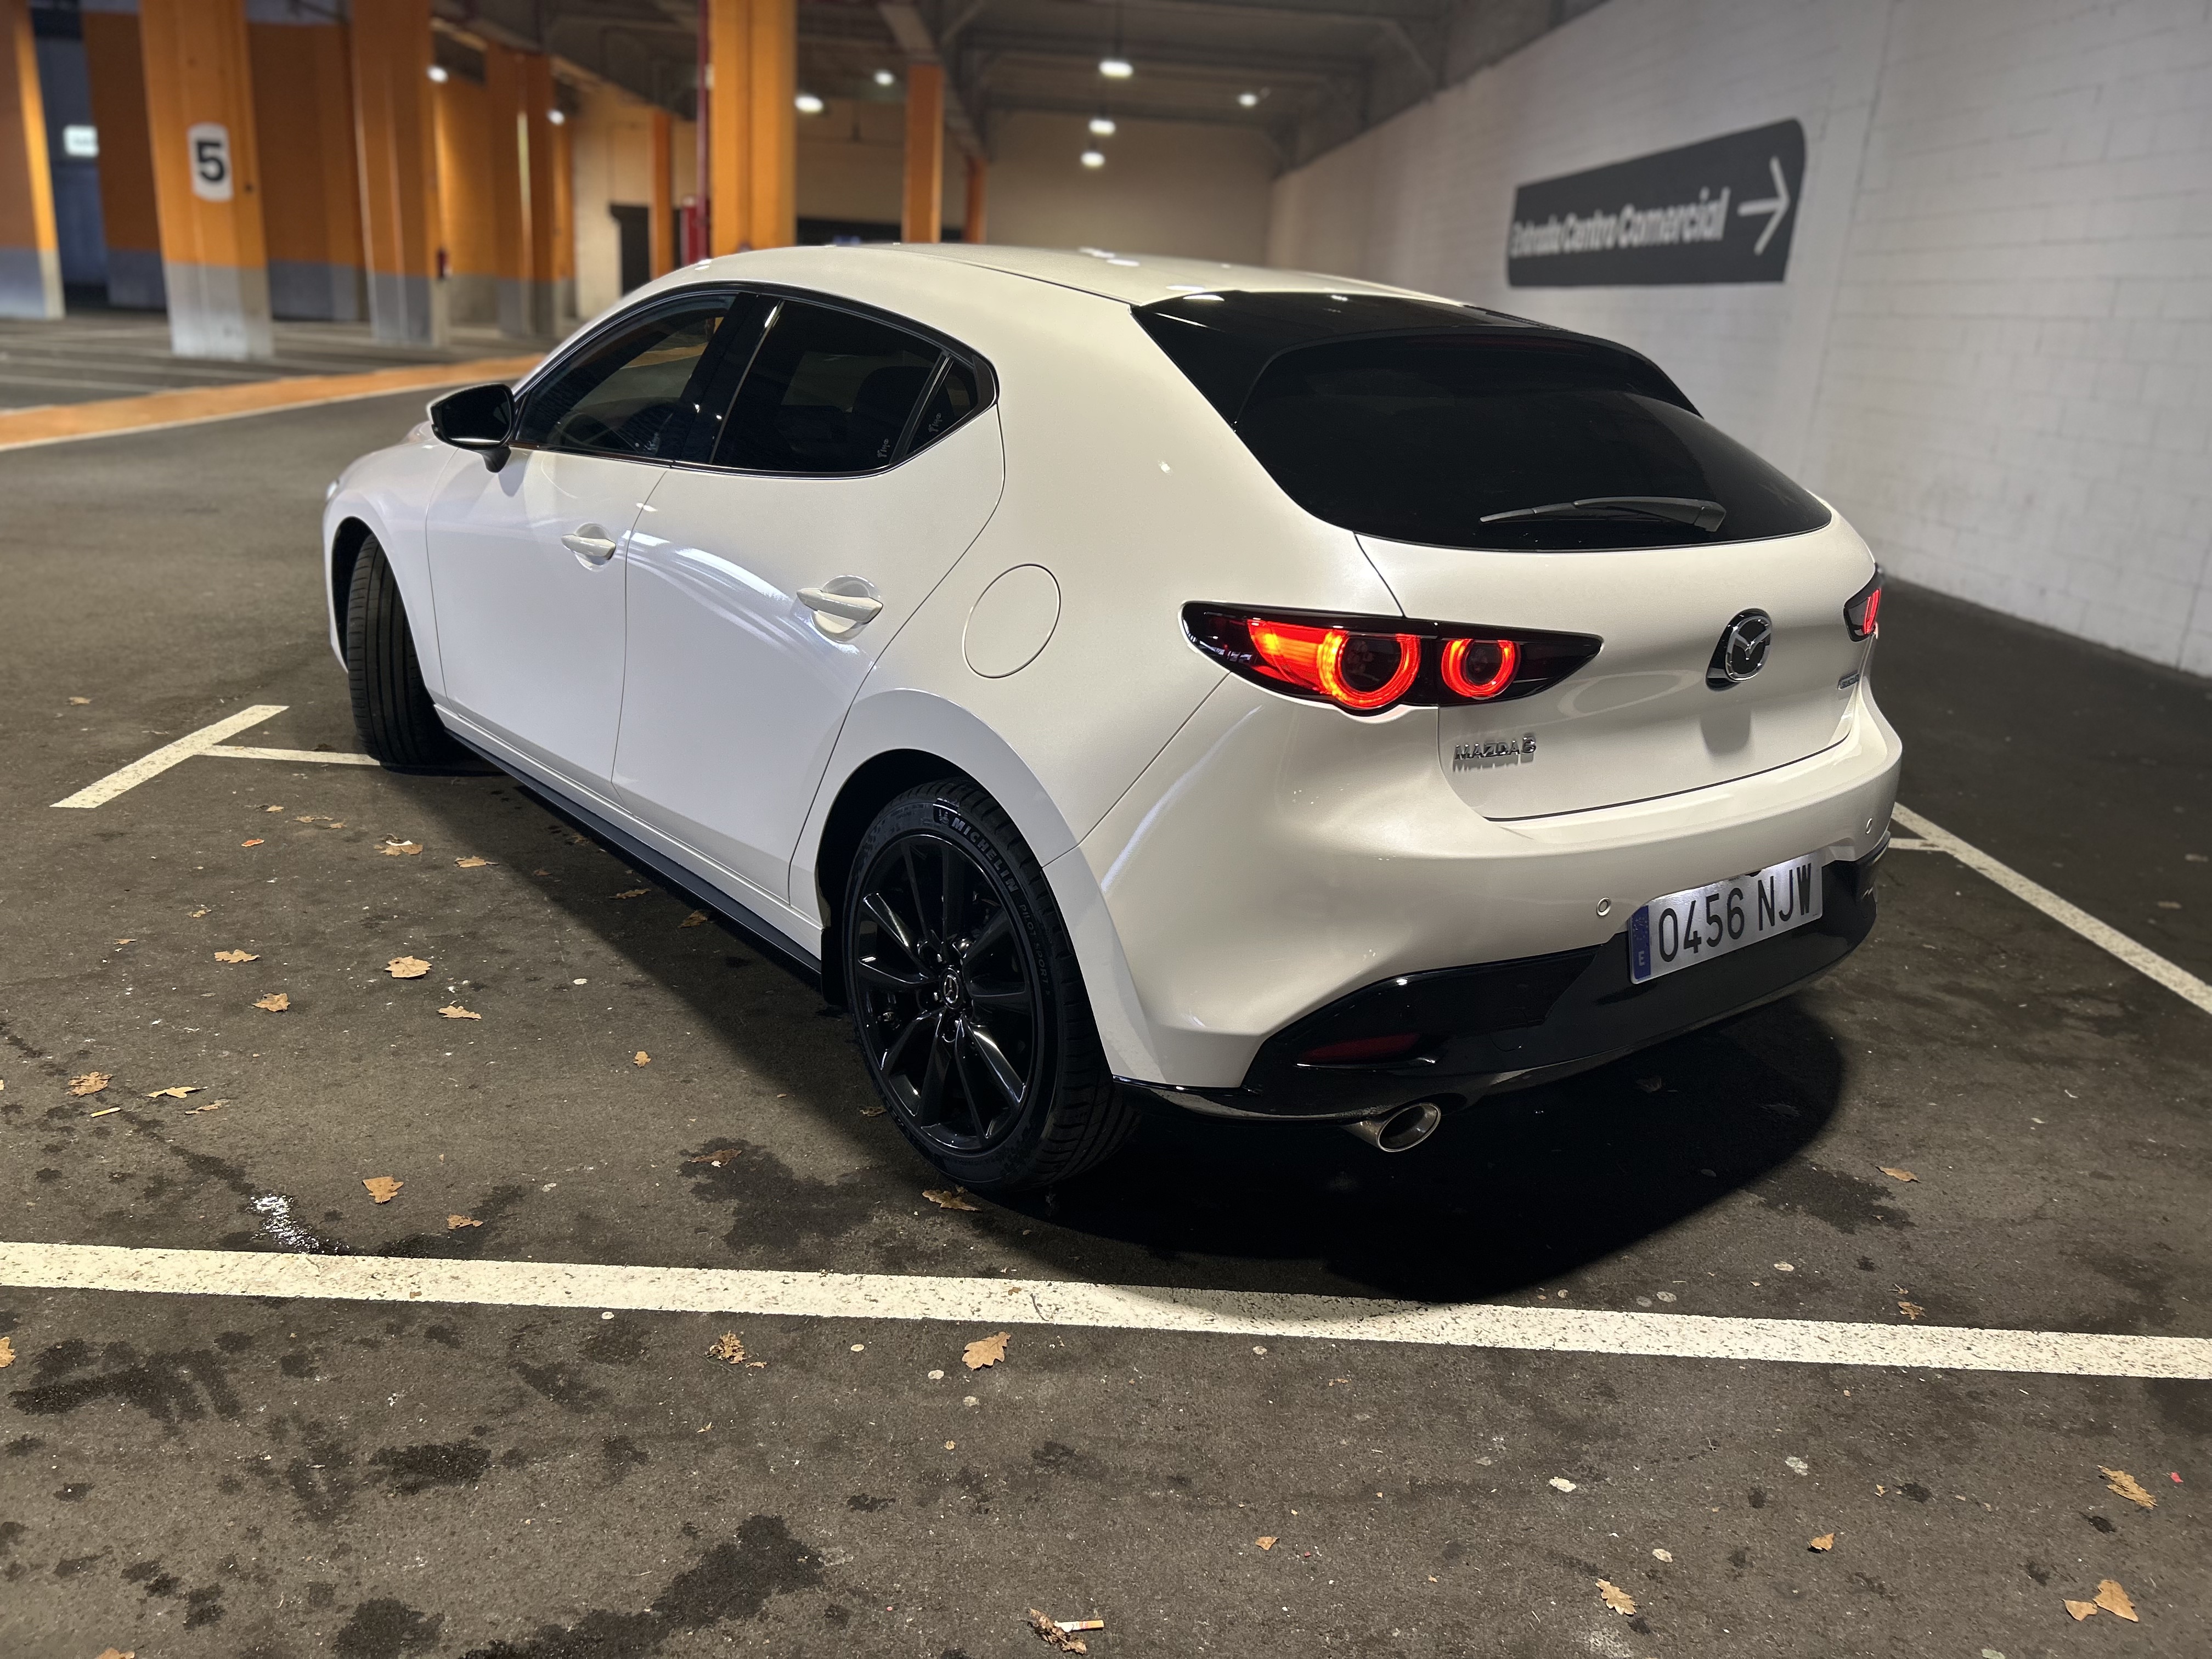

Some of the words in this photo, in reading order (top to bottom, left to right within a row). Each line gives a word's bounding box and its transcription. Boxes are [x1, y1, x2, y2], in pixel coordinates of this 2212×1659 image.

[196, 140, 225, 182] 5
[1564, 209, 1618, 253] Centro
[1618, 187, 1730, 247] Comercial
[951, 816, 1019, 893] MICHELIN
[1019, 904, 1036, 936] PILOT
[1034, 942, 1048, 985] SPORT
[1658, 887, 1745, 962] 0456
[1758, 862, 1812, 931] NJW
[1638, 950, 1645, 966] E
